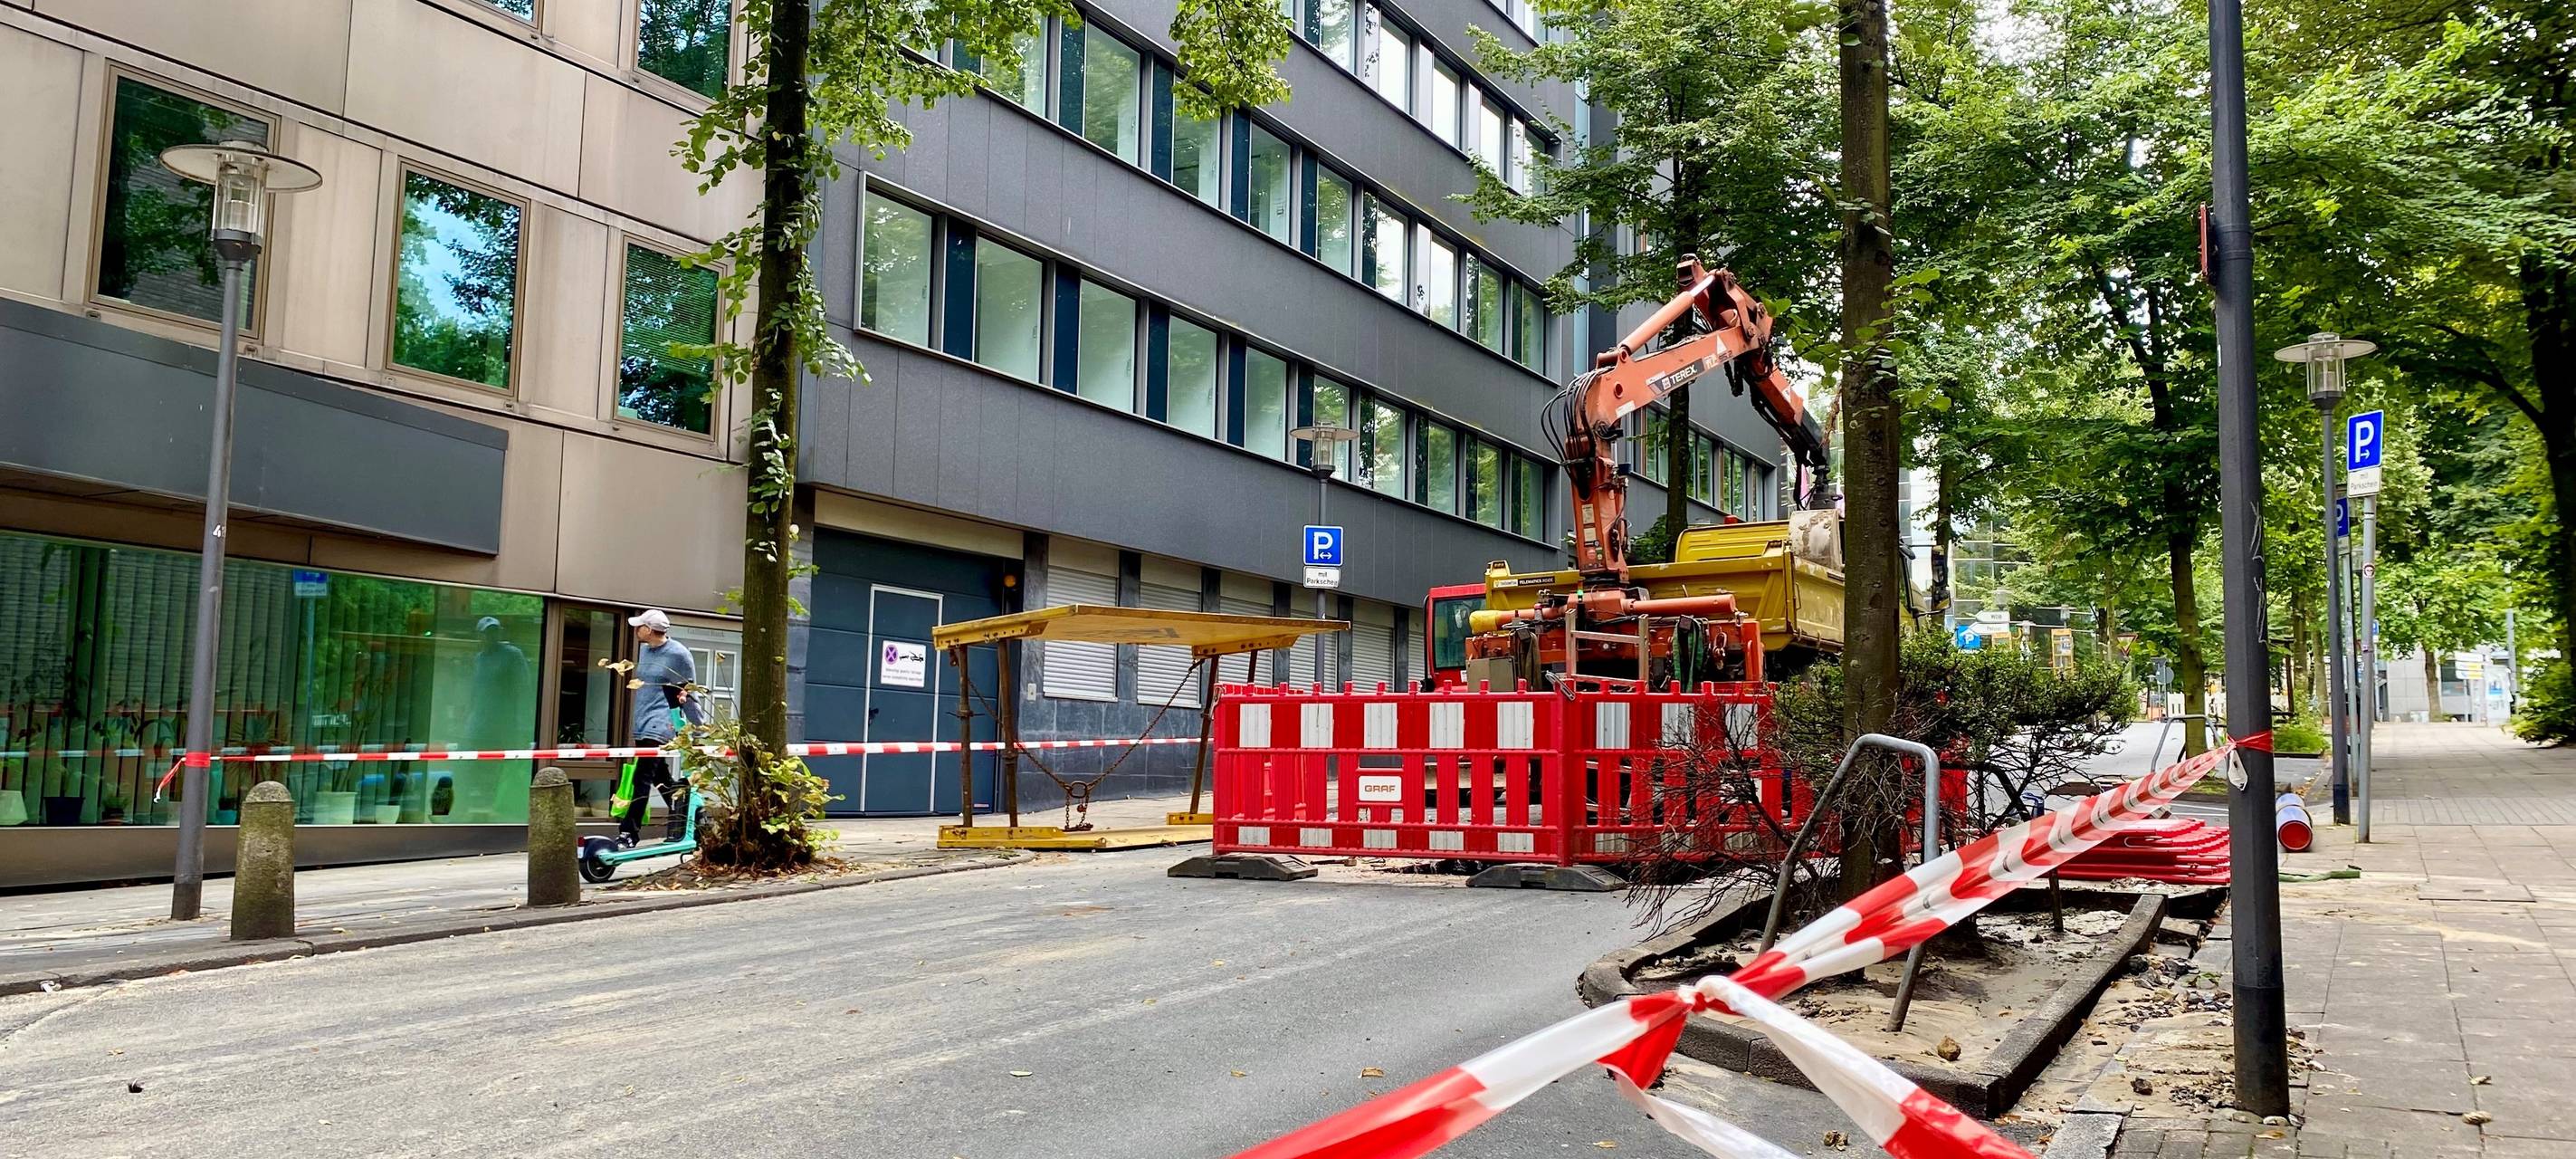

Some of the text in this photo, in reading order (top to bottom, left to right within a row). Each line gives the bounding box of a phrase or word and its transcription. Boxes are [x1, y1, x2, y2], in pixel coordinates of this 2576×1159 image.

[1670, 365, 1697, 384] TEREX
[2354, 420, 2374, 463] P
[1313, 532, 1333, 560] P
[1364, 784, 1396, 793] GRAF
